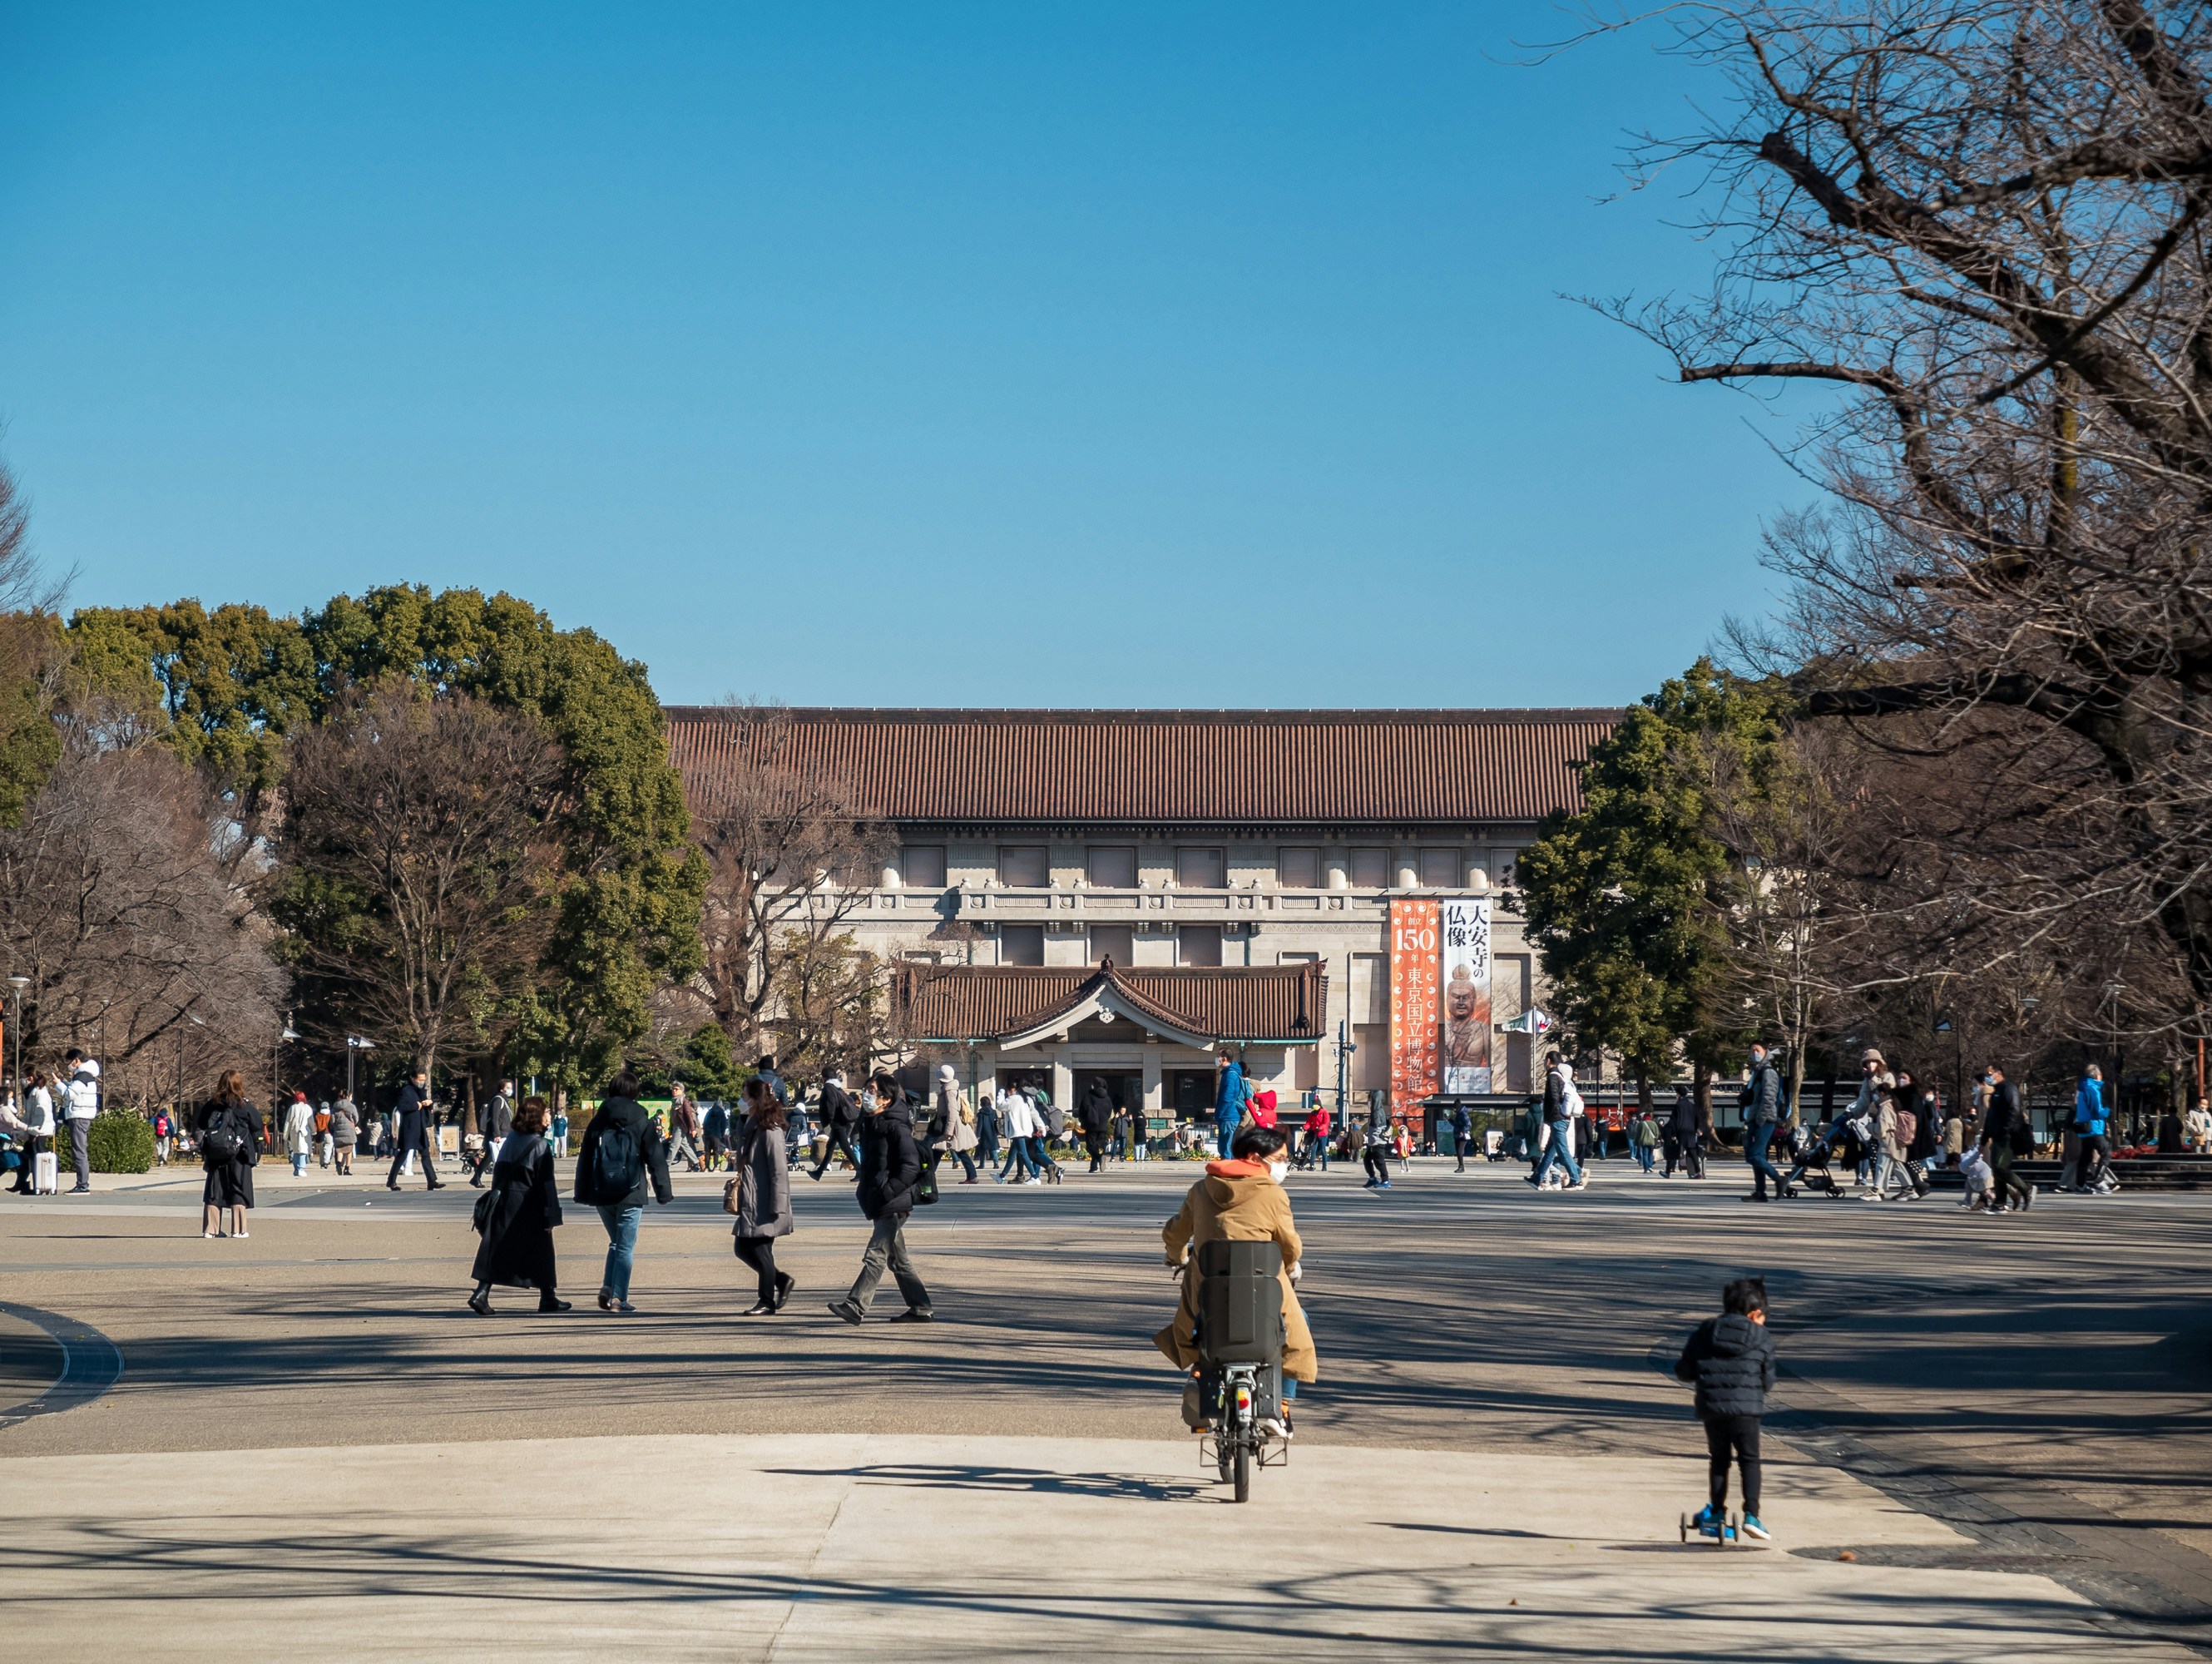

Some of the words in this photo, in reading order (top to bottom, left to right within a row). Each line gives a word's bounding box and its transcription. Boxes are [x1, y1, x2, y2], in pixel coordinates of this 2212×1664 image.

[1408, 917, 1422, 925] 創立
[1446, 905, 1467, 948] 仏像
[1395, 929, 1435, 951] 150
[1467, 905, 1488, 978] 大安寺の
[1410, 953, 1419, 963] 年
[1406, 967, 1423, 1092] 東京国立博物館
